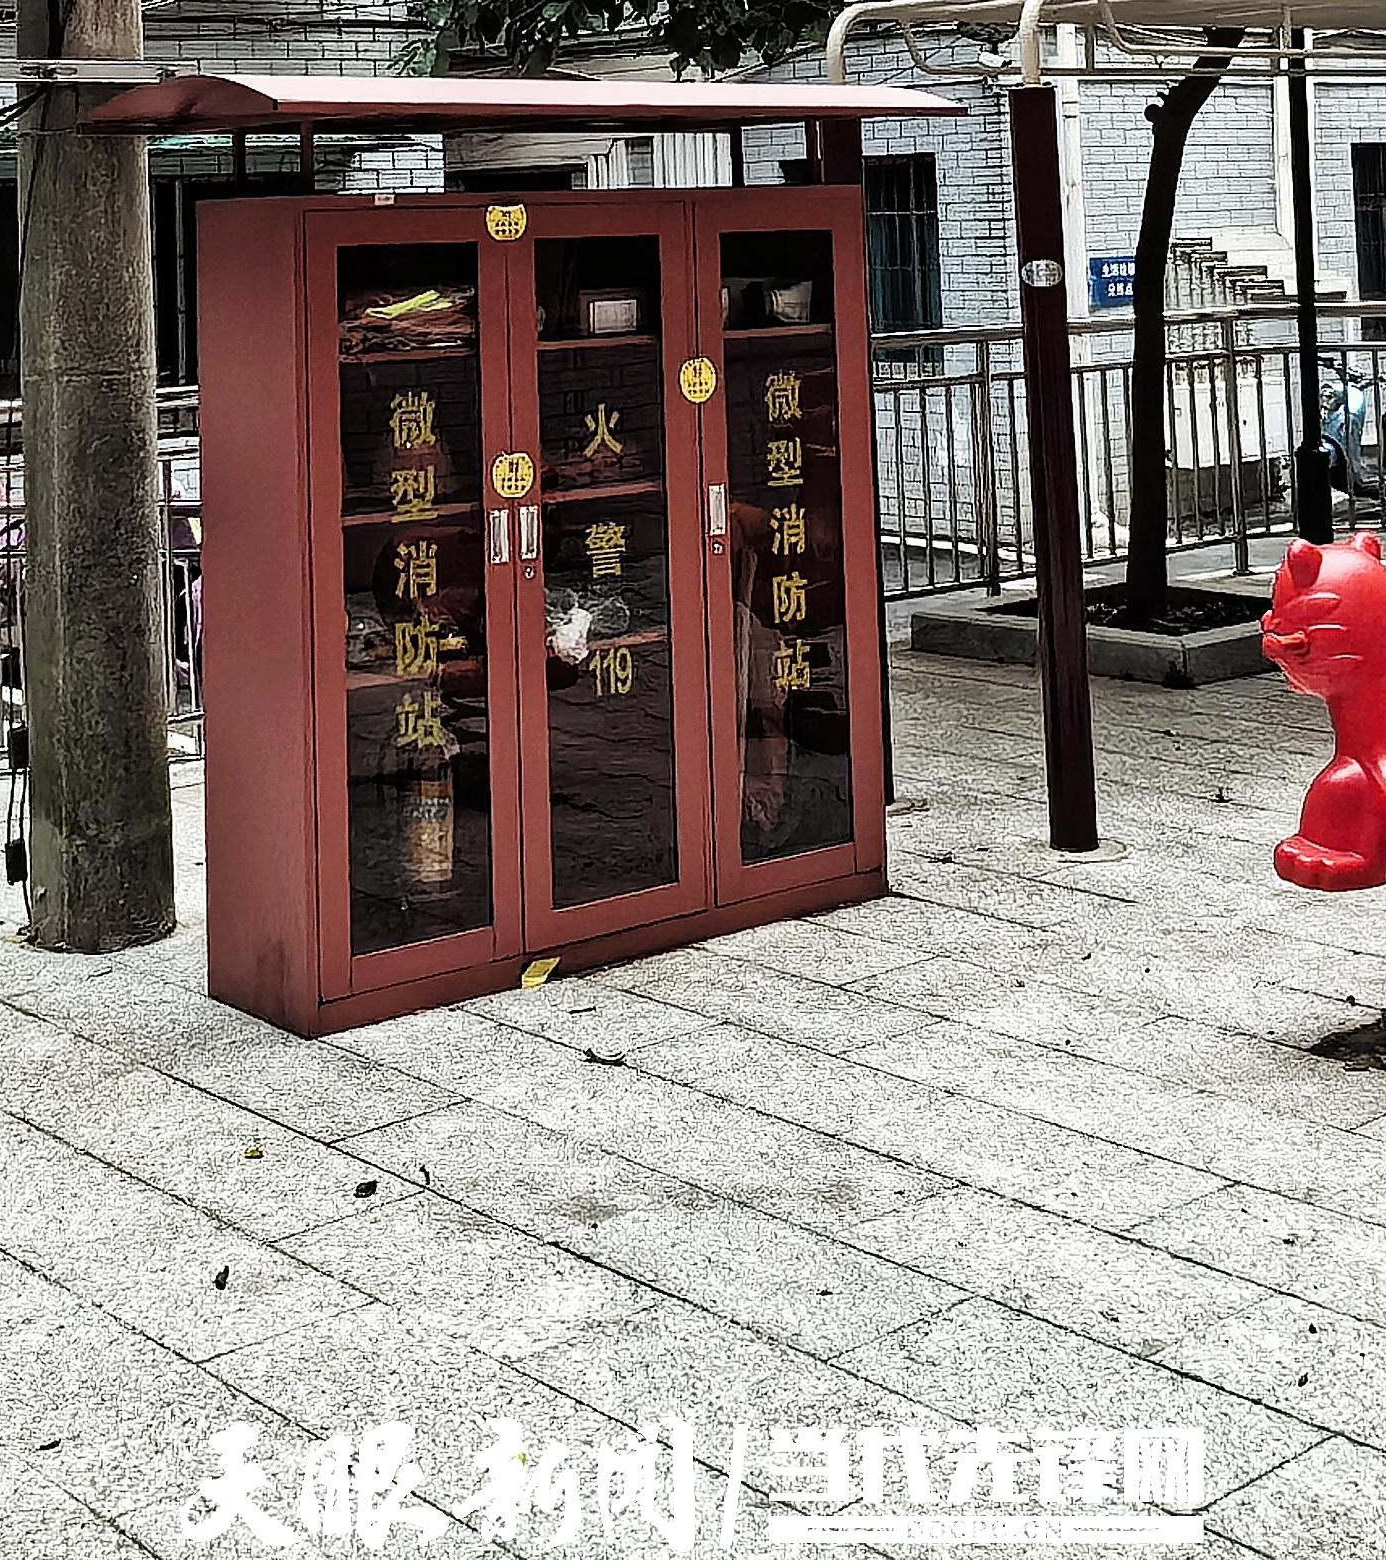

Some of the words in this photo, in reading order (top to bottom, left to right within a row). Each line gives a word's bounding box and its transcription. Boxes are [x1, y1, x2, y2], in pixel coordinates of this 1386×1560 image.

[389, 390, 444, 747] 微型消防站
[583, 403, 626, 579] 火警
[765, 371, 811, 689] 微型消防站
[589, 647, 633, 697] 119
